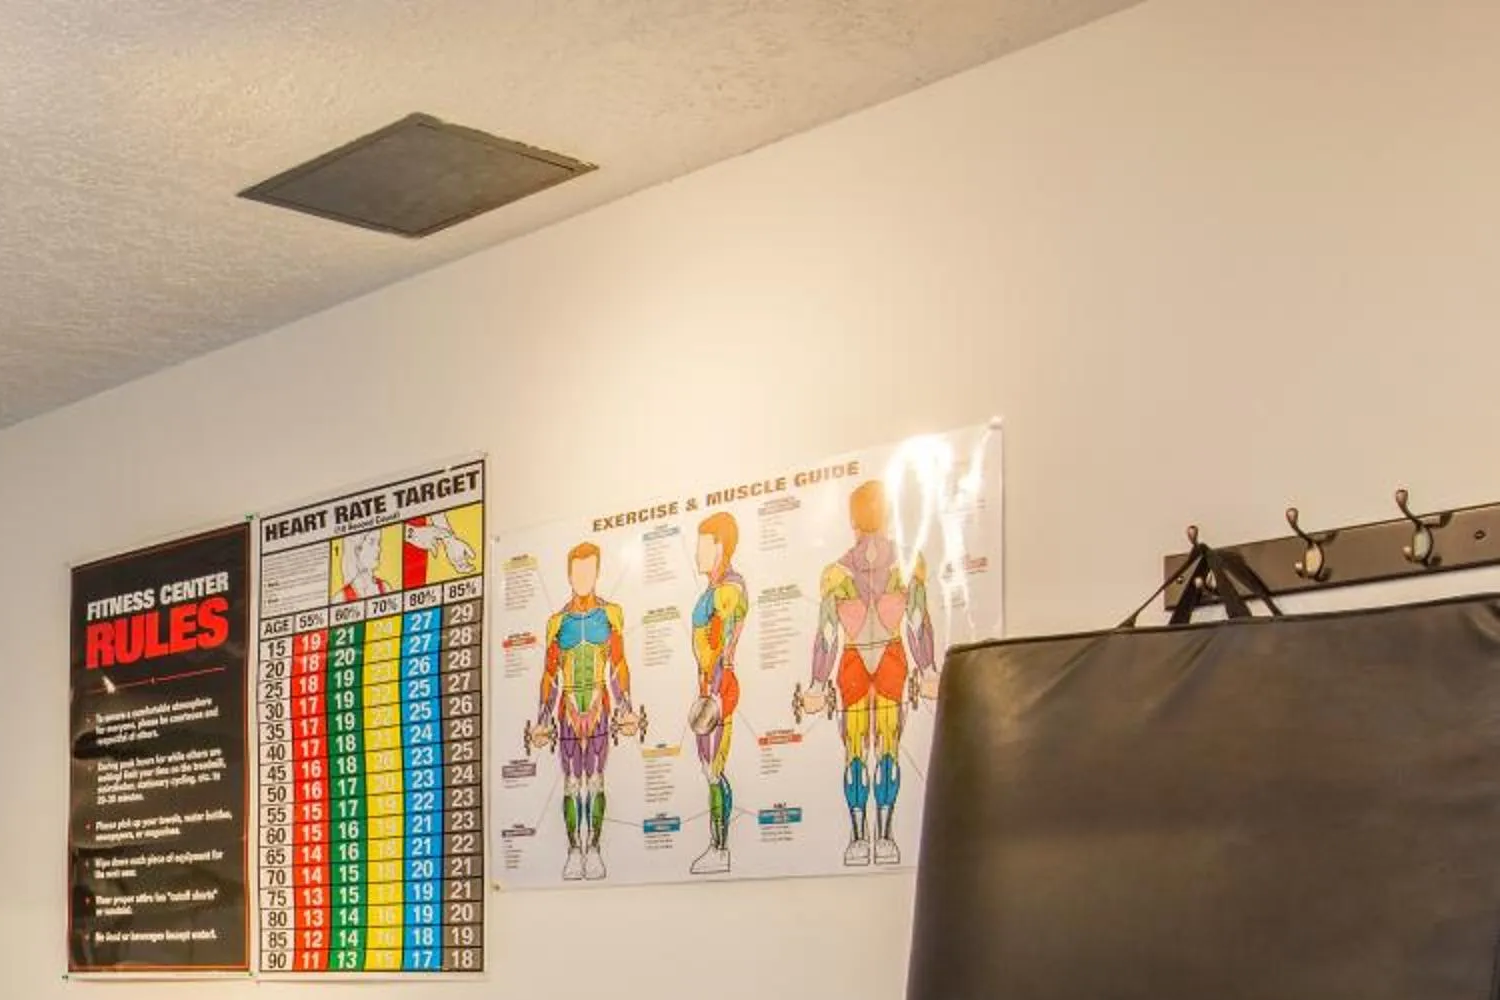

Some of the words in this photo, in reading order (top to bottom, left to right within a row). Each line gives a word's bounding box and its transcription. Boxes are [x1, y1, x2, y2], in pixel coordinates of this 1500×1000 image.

[265, 510, 328, 542] HEART
[335, 495, 387, 524] RATE
[394, 470, 480, 509] TARGET
[592, 502, 678, 532] EXERCISE
[685, 498, 698, 512] &
[706, 477, 787, 507] MUSCLE
[793, 461, 860, 488] GUIDE
[87, 588, 155, 621] FITNESS
[160, 571, 229, 605] CENTER
[264, 619, 289, 635] AGE
[299, 610, 324, 628] 55%
[372, 597, 397, 614] 70%
[409, 589, 436, 607] 80%
[449, 580, 476, 598] 85%
[86, 597, 229, 670] RULES
[268, 640, 285, 657] 15
[303, 633, 321, 651] 19
[336, 626, 354, 645] 21
[411, 612, 432, 631] 27
[451, 604, 473, 623] 29
[265, 660, 284, 678] 20
[302, 653, 320, 672] 18
[335, 648, 355, 666] 20
[410, 634, 431, 653] 27
[449, 626, 472, 646] 28
[265, 682, 283, 700] 25
[300, 675, 318, 693] 18
[335, 669, 354, 688] 19
[409, 657, 430, 676] 26
[449, 649, 471, 669] 28
[266, 702, 284, 721] 30
[300, 696, 318, 715] 17
[335, 691, 354, 709] 19
[409, 679, 430, 699] 25
[449, 672, 470, 692] 27
[265, 724, 285, 741] 35
[301, 717, 318, 736] 17
[336, 712, 355, 730] 19
[410, 702, 431, 721] 25
[450, 695, 472, 715] 26
[267, 744, 285, 760] 40
[302, 739, 319, 757] 17
[337, 734, 356, 752] 18
[411, 724, 432, 743] 24
[451, 718, 473, 738] 26
[267, 765, 286, 781] 45
[302, 760, 321, 777] 16
[338, 756, 357, 774] 18
[412, 746, 433, 766] 23
[452, 742, 473, 761] 25
[268, 786, 286, 802] 50
[304, 781, 322, 799] 16
[338, 777, 356, 796] 17
[413, 769, 434, 788] 23
[452, 765, 473, 784] 24
[268, 807, 286, 824] 55
[303, 803, 322, 820] 15
[339, 800, 358, 817] 17
[413, 792, 434, 810] 22
[452, 788, 473, 807] 23
[267, 828, 286, 844] 60
[303, 824, 322, 841] 15
[339, 820, 358, 838] 16
[413, 815, 431, 833] 21
[452, 811, 474, 830] 23
[266, 848, 285, 864] 65
[303, 845, 322, 862] 14
[340, 842, 359, 860] 16
[412, 838, 431, 855] 21
[452, 834, 473, 853] 22
[267, 869, 285, 885] 70
[303, 867, 322, 884] 14
[340, 864, 358, 882] 15
[412, 860, 433, 878] 20
[452, 858, 471, 876] 21
[268, 890, 286, 906] 75
[304, 888, 323, 906] 13
[340, 886, 359, 904] 15
[414, 882, 433, 900] 19
[451, 881, 470, 898] 21
[268, 911, 287, 929] 80
[304, 909, 323, 927] 13
[340, 908, 358, 925] 14
[414, 905, 433, 923] 19
[451, 904, 473, 921] 20
[268, 951, 286, 968] 90
[303, 952, 319, 969] 11
[338, 951, 357, 968] 13
[413, 950, 432, 968] 17
[452, 949, 473, 968] 18
[269, 932, 287, 949] 85
[304, 930, 322, 948] 12
[340, 930, 358, 947] 14
[414, 928, 433, 946] 18
[452, 927, 473, 945] 19
